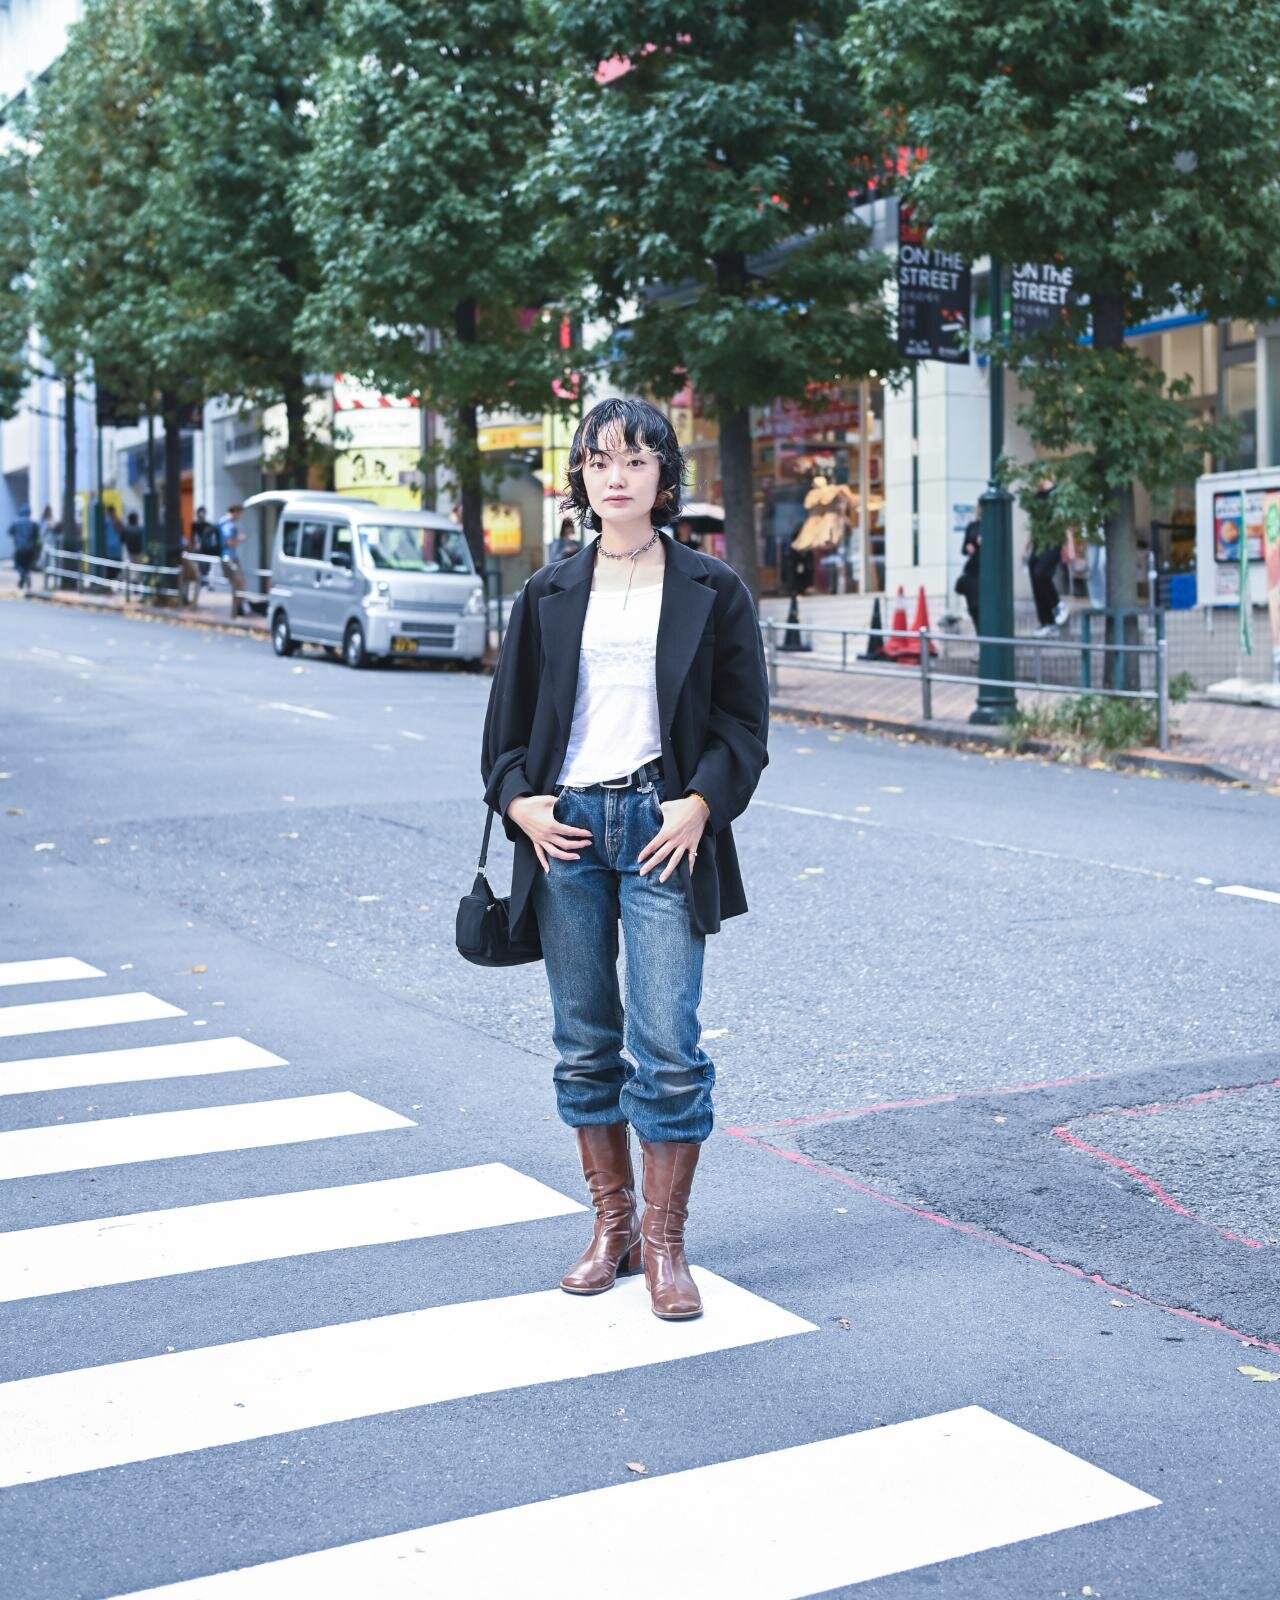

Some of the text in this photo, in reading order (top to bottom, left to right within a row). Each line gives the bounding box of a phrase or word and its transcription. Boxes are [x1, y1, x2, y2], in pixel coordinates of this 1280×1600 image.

[900, 246, 964, 270] ON THE
[900, 267, 960, 290] STREET
[1042, 264, 1073, 285] THE
[1012, 280, 1068, 304] STREET
